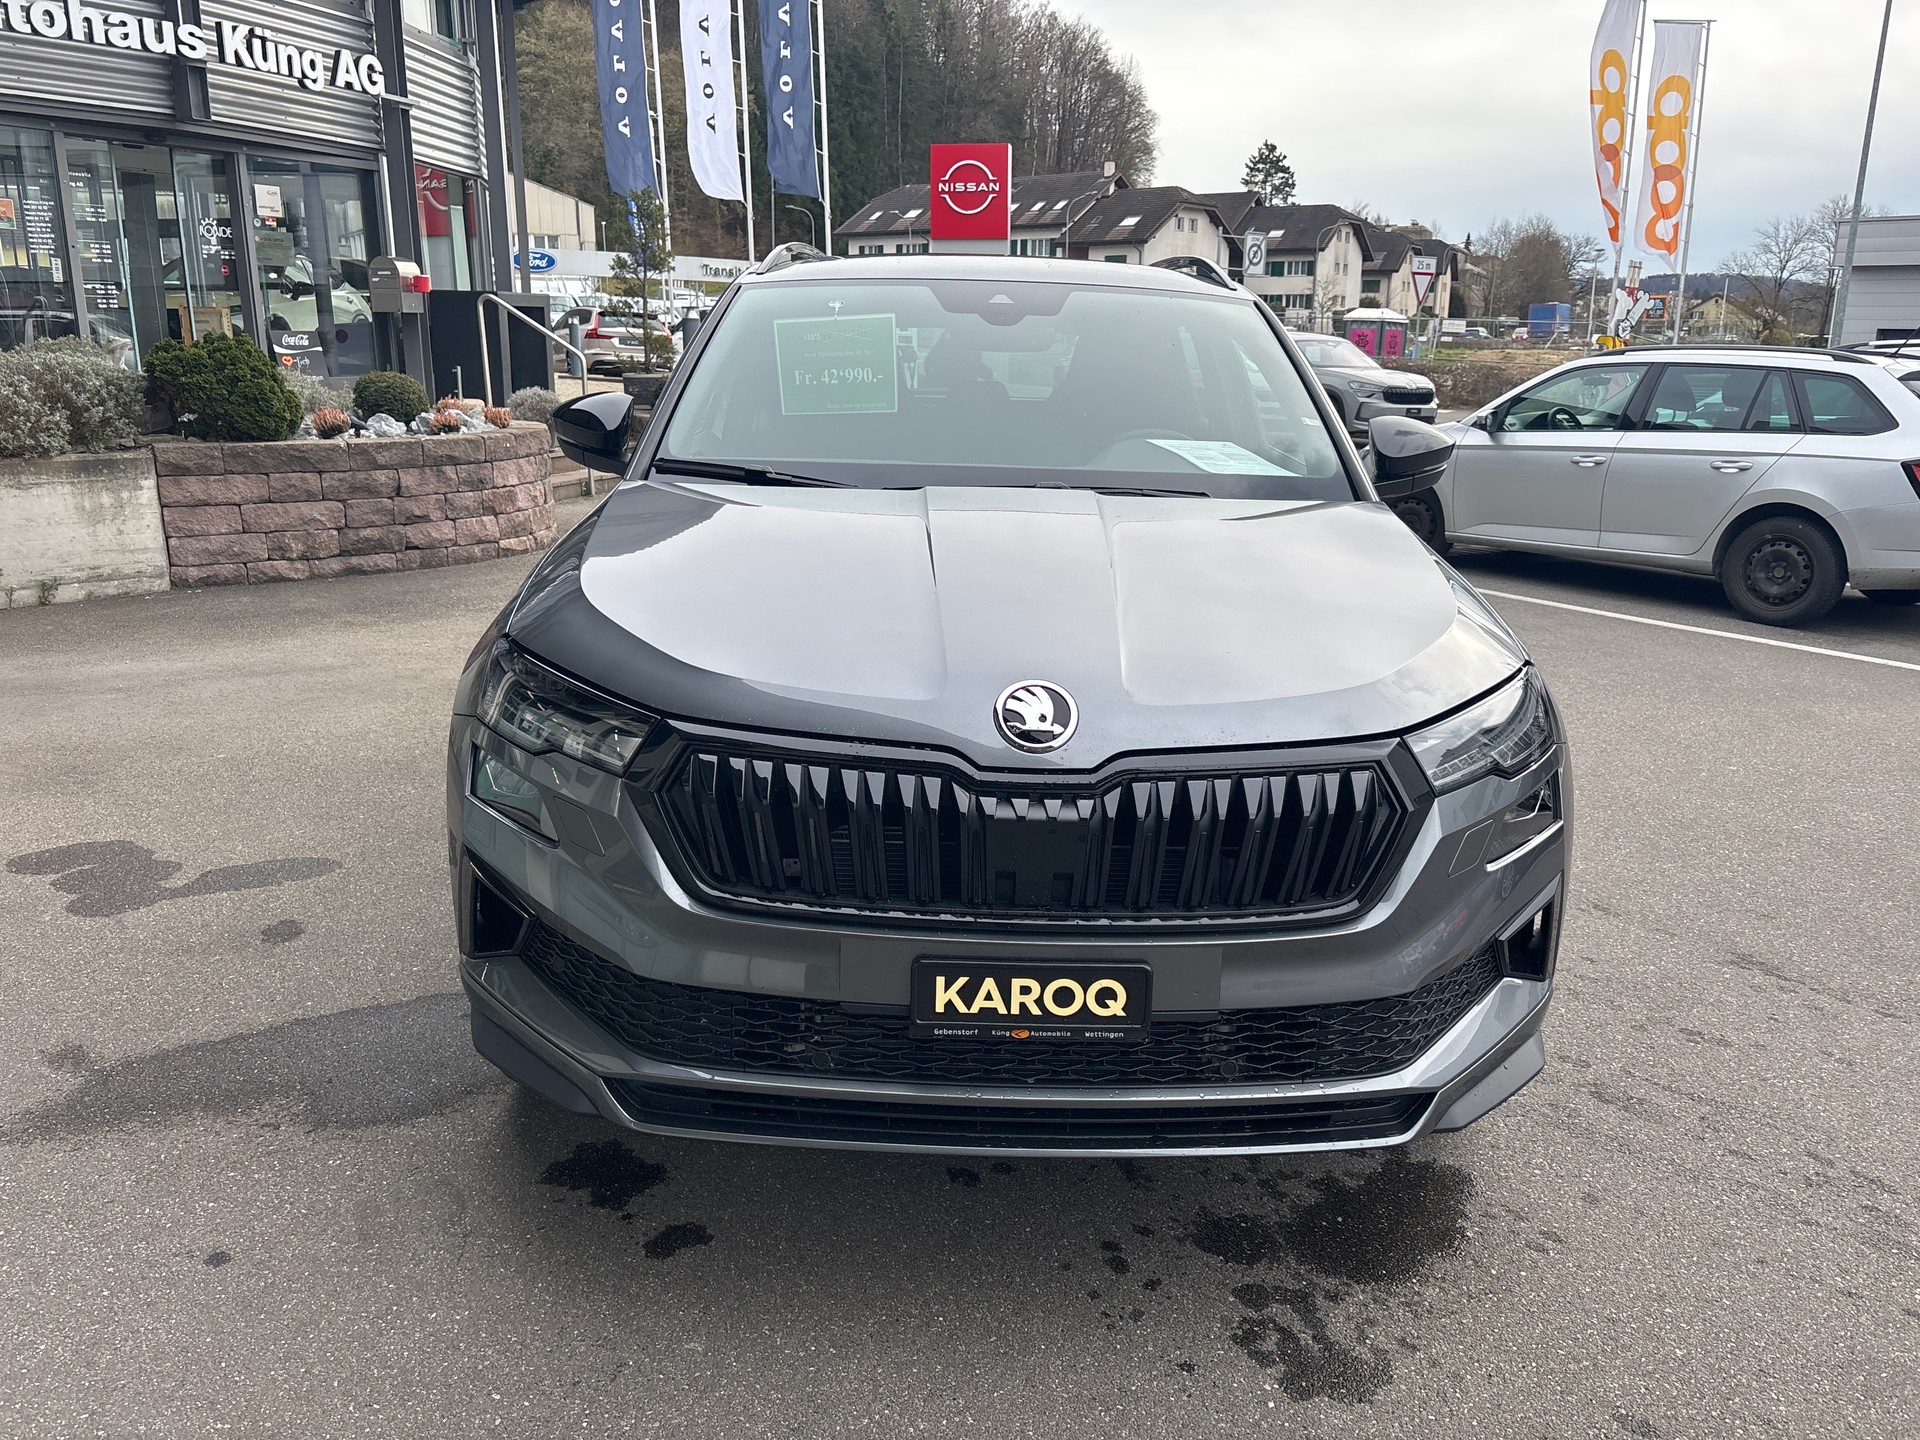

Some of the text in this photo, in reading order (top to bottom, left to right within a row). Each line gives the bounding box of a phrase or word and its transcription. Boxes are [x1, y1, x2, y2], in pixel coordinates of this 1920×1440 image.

[0, 0, 386, 96] tohaus Küng AG
[938, 182, 1000, 192] NISSAN
[1416, 260, 1425, 270] 25
[794, 369, 817, 385] Fr.
[934, 975, 1128, 1017] KAROQ
[933, 1027, 1124, 1039] Gebenstorf Küng Automobile Wettingen
